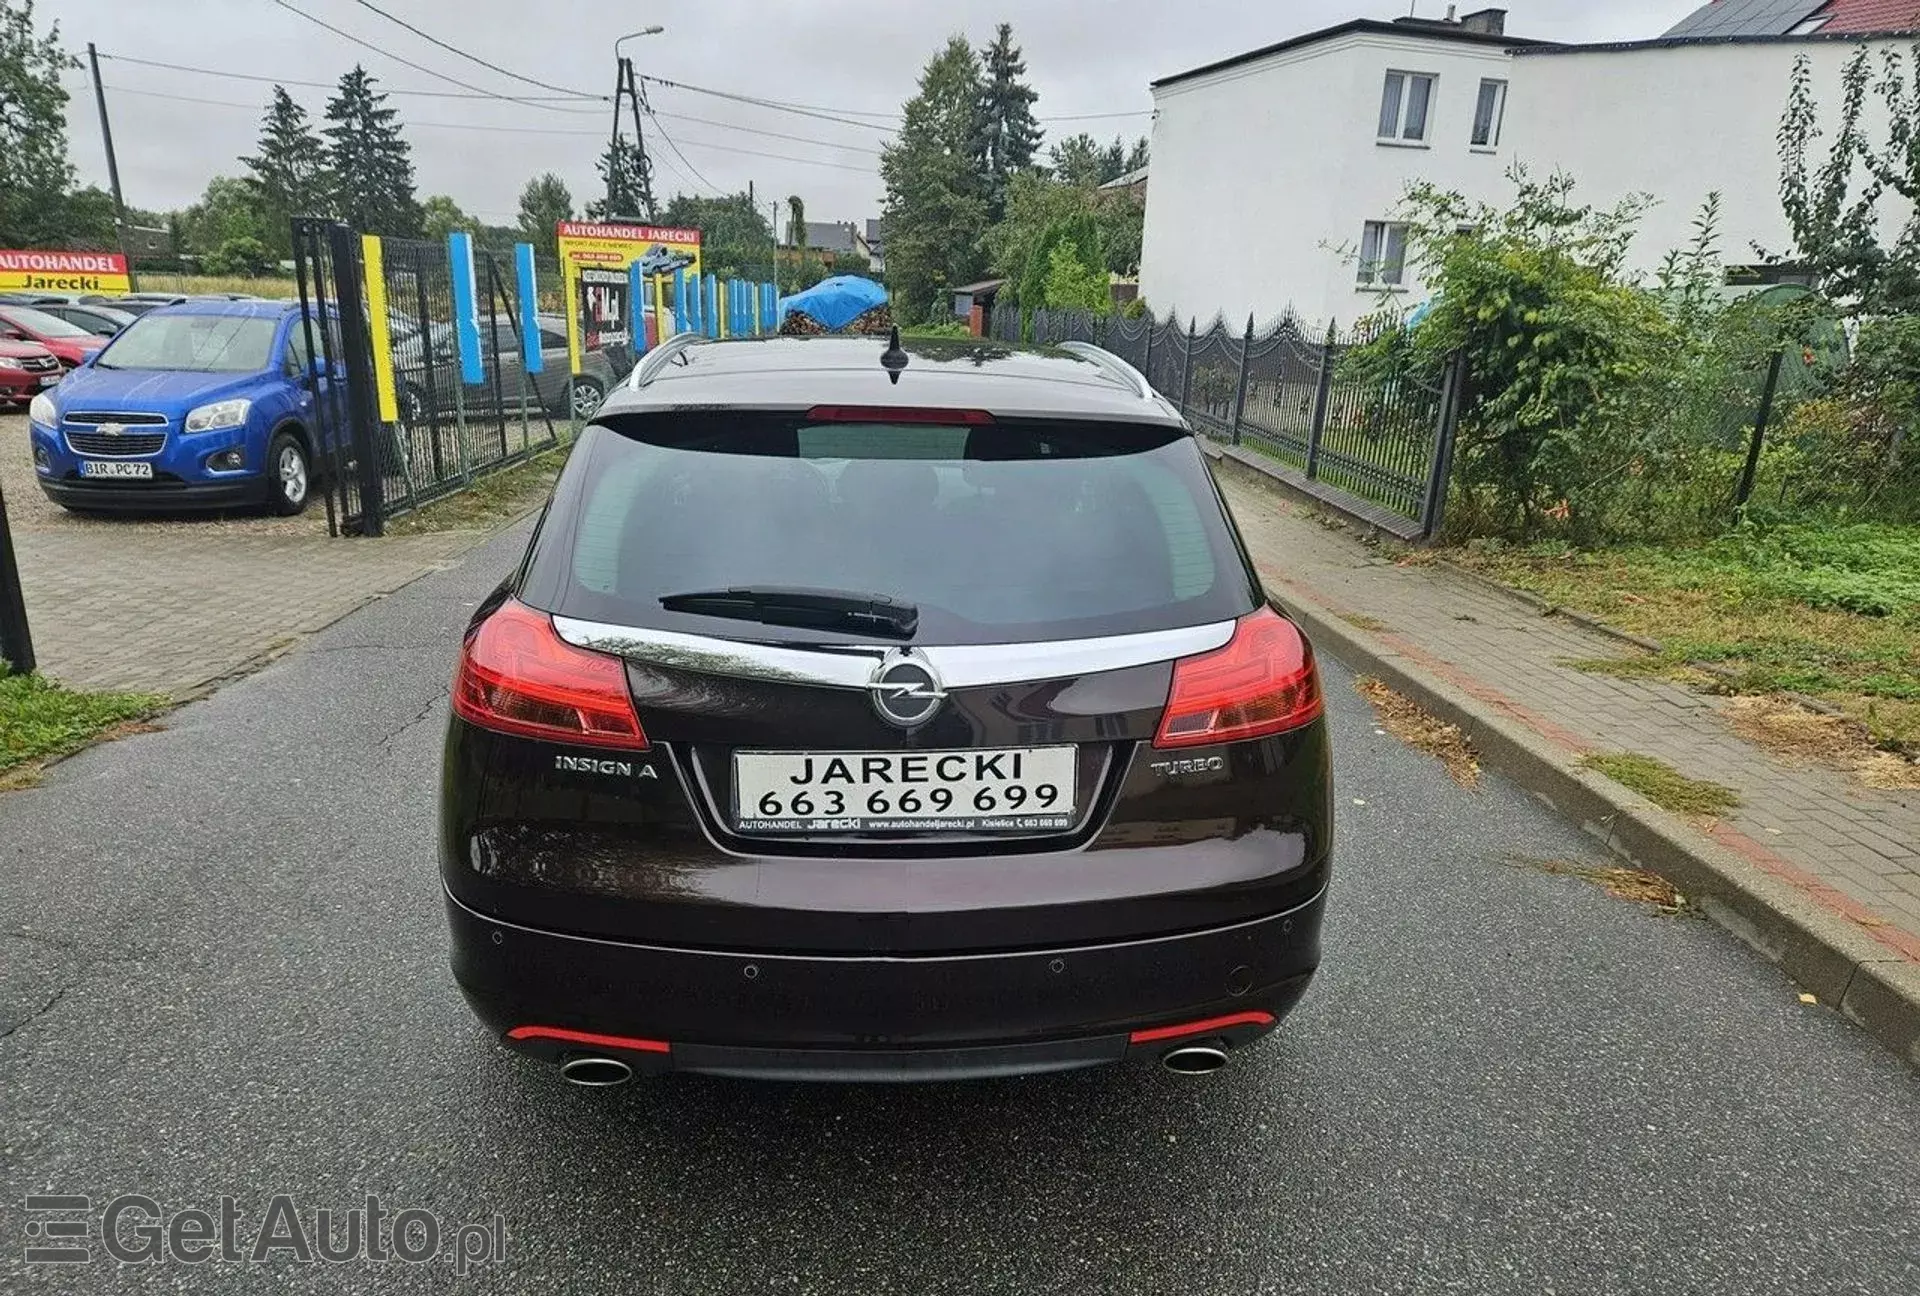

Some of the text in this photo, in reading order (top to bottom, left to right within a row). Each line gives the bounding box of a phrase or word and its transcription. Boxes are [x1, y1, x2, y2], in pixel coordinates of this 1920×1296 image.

[563, 225, 695, 242] AUTOHANDEL JARECKI
[0, 254, 119, 272] AUTOHANDEL
[22, 274, 99, 290] Jarecki
[85, 463, 108, 474] BIR
[789, 753, 1022, 785] JARECKI
[1150, 756, 1224, 777] TURBO
[758, 783, 1059, 816] 663 669 699
[738, 820, 802, 830] AUTOHANDEL
[807, 818, 861, 830] Jarecki
[868, 819, 975, 830] www.autohandeljarecki.pl
